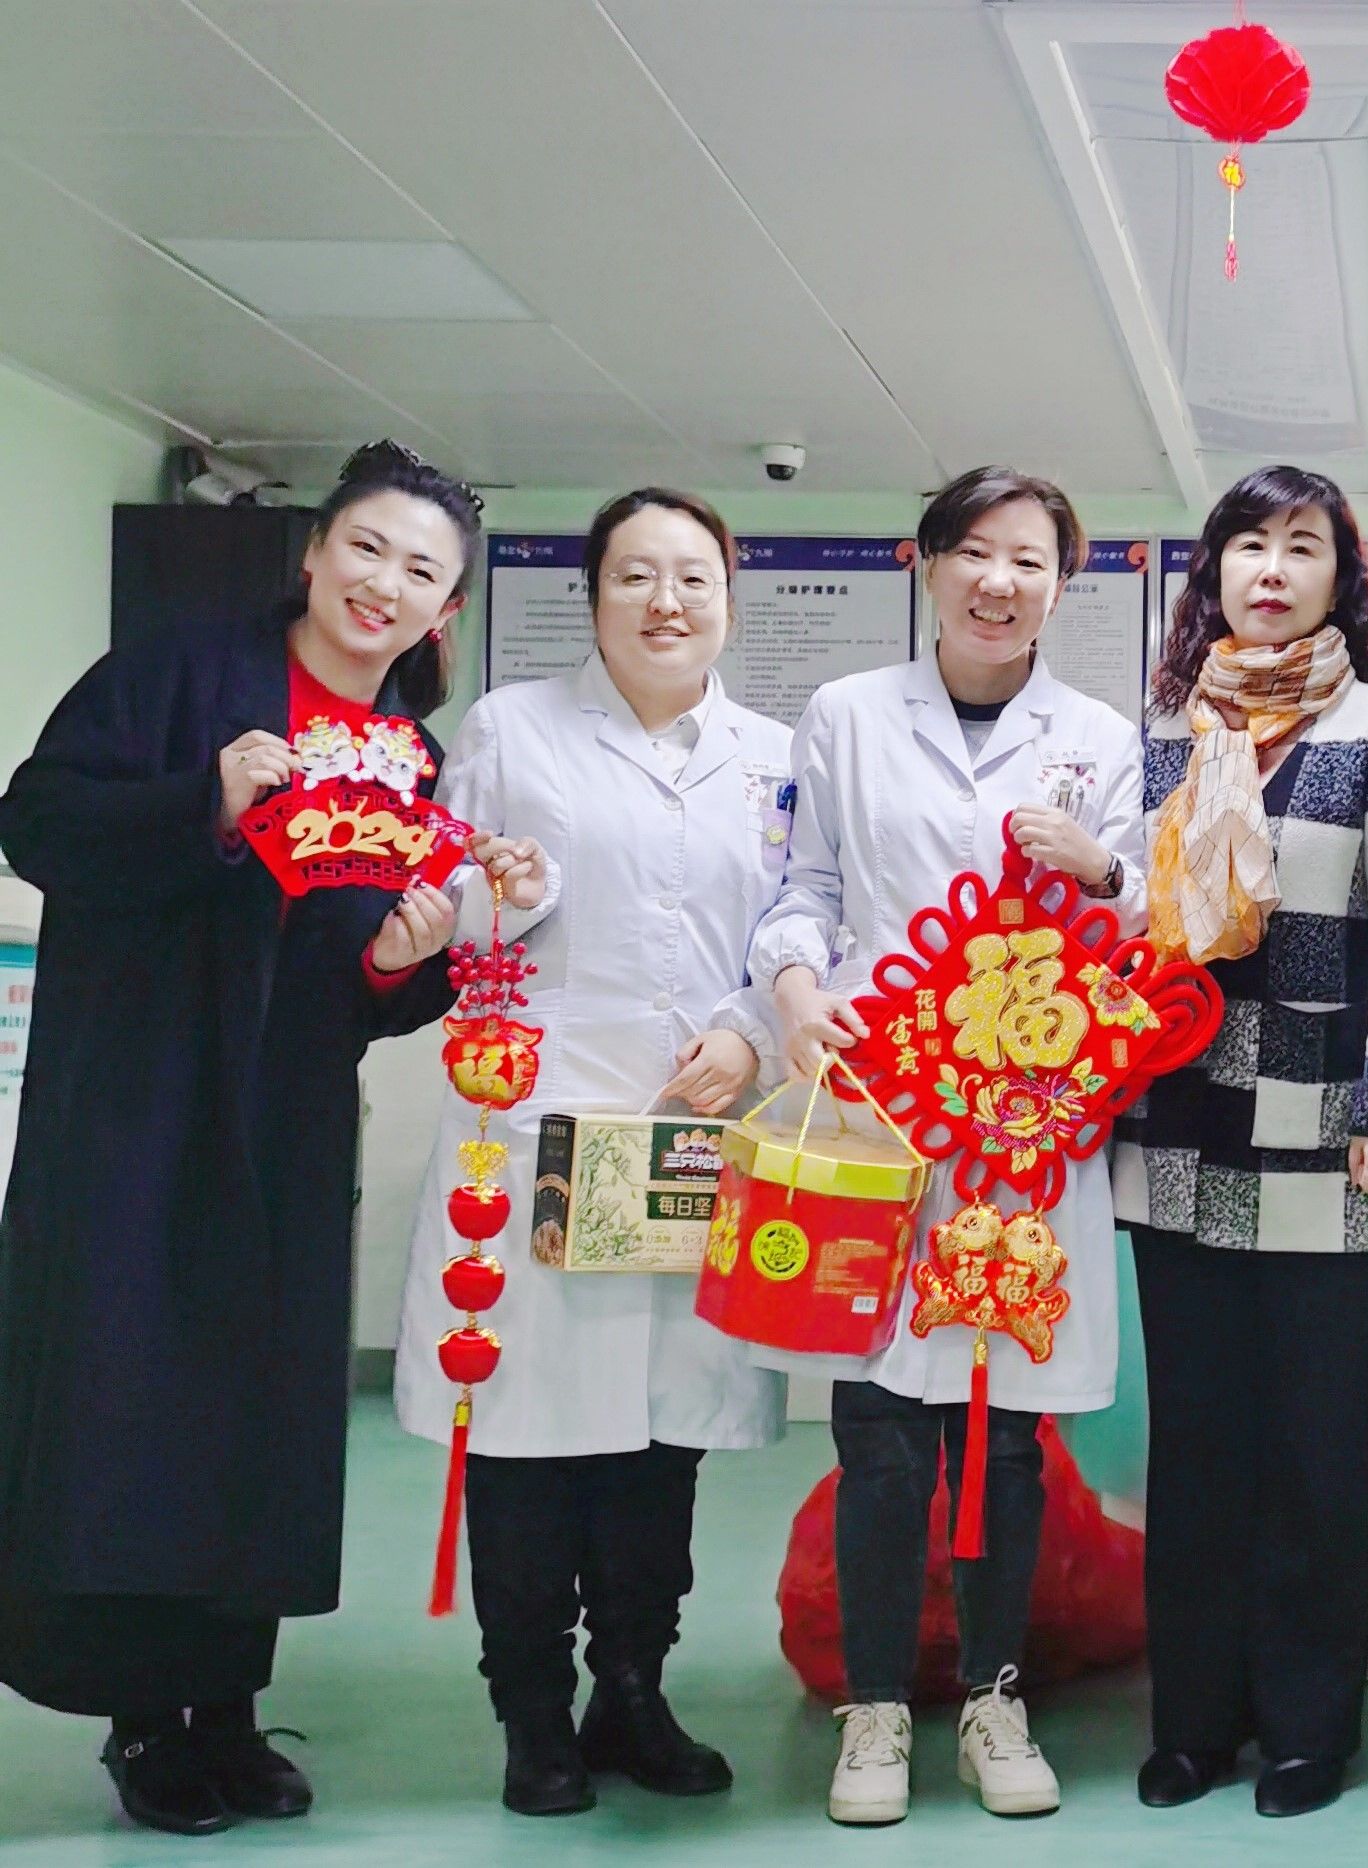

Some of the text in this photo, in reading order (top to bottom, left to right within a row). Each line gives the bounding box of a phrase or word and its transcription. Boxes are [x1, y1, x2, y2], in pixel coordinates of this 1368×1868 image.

[286, 797, 438, 867] 2024
[944, 928, 1090, 1071] 福
[657, 1196, 712, 1217] 每日坚
[952, 1253, 988, 1298] 福
[995, 1263, 1033, 1304] 福
